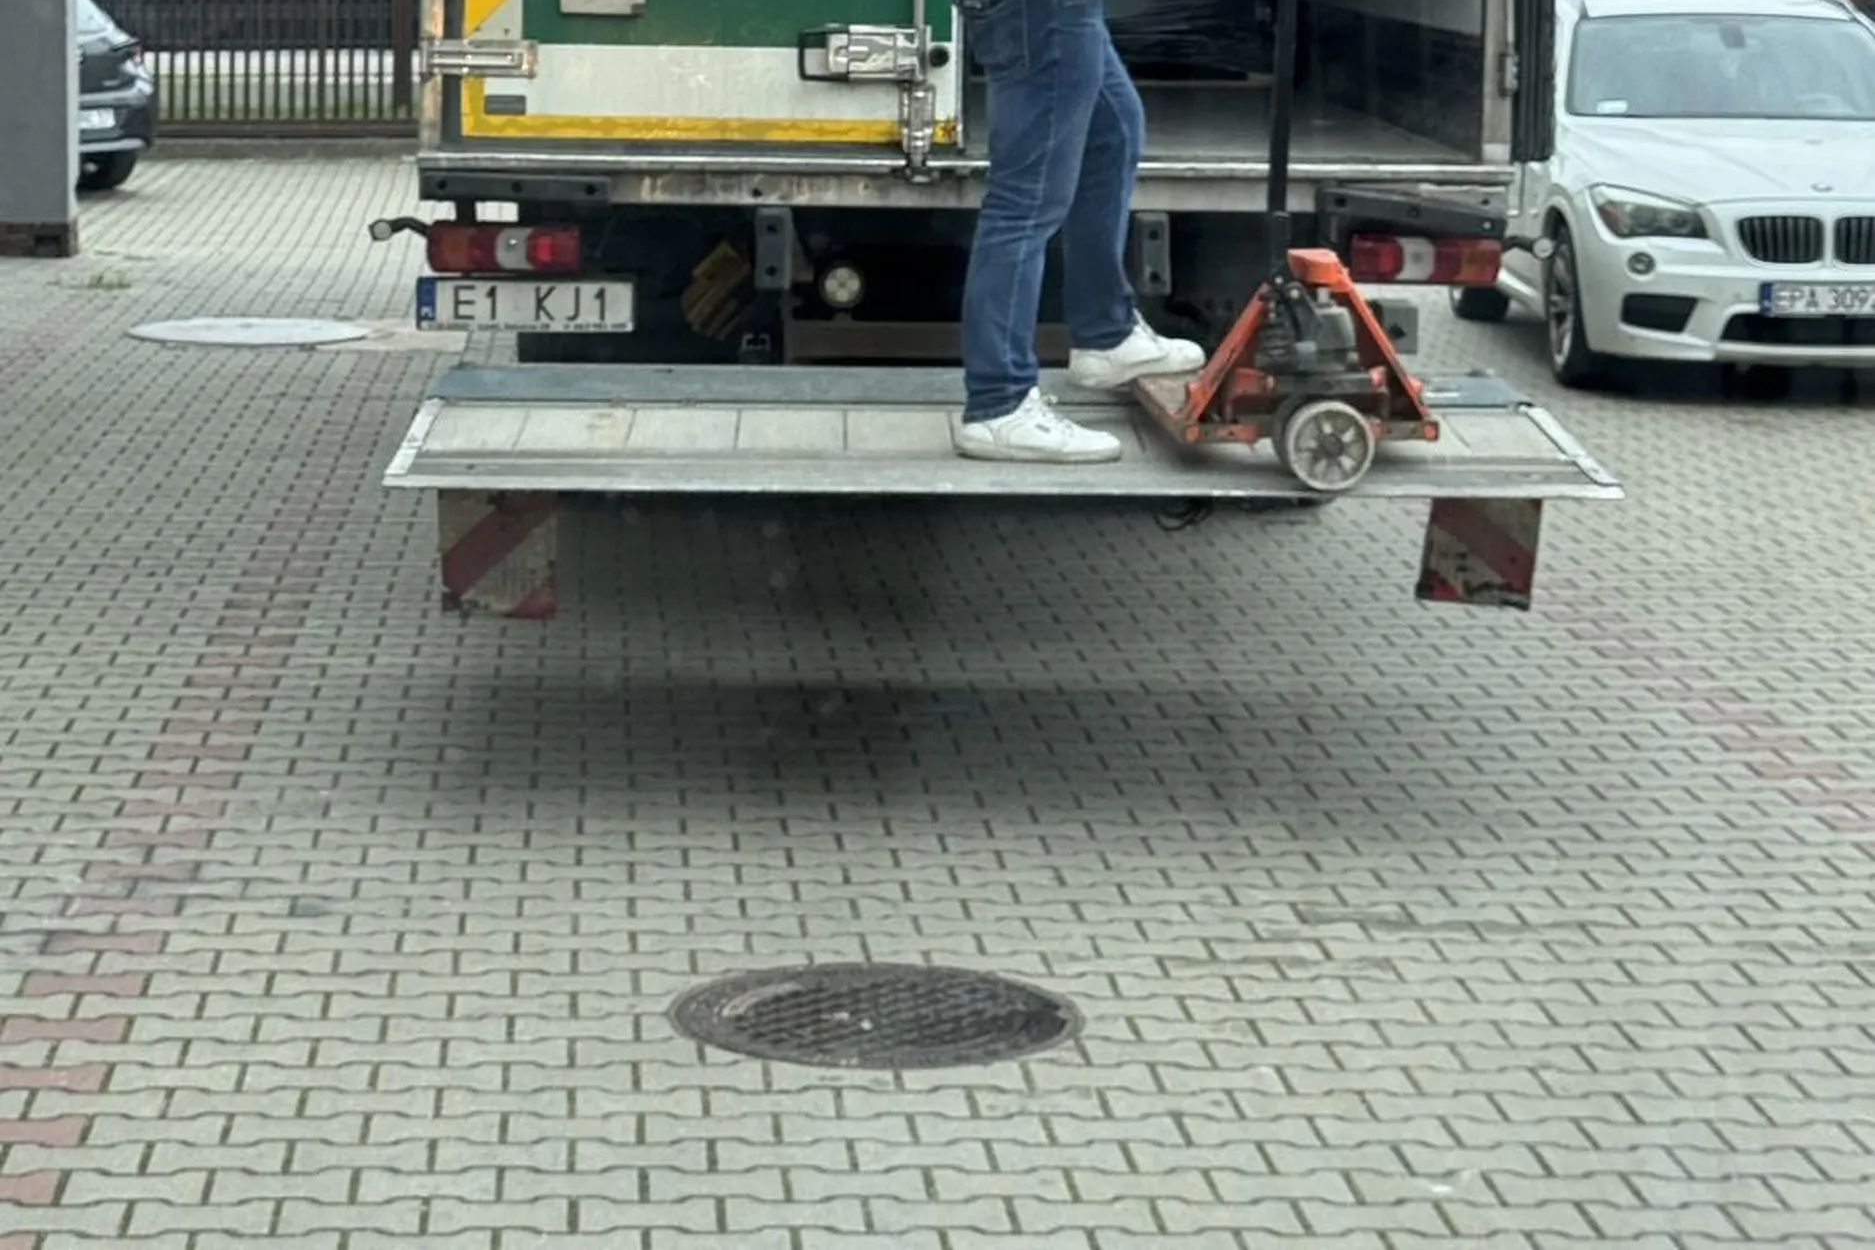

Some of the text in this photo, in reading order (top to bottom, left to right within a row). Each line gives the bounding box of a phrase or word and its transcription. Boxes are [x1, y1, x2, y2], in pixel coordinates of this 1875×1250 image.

[453, 284, 607, 321] E1 KJ1
[1827, 287, 1875, 310] 309
